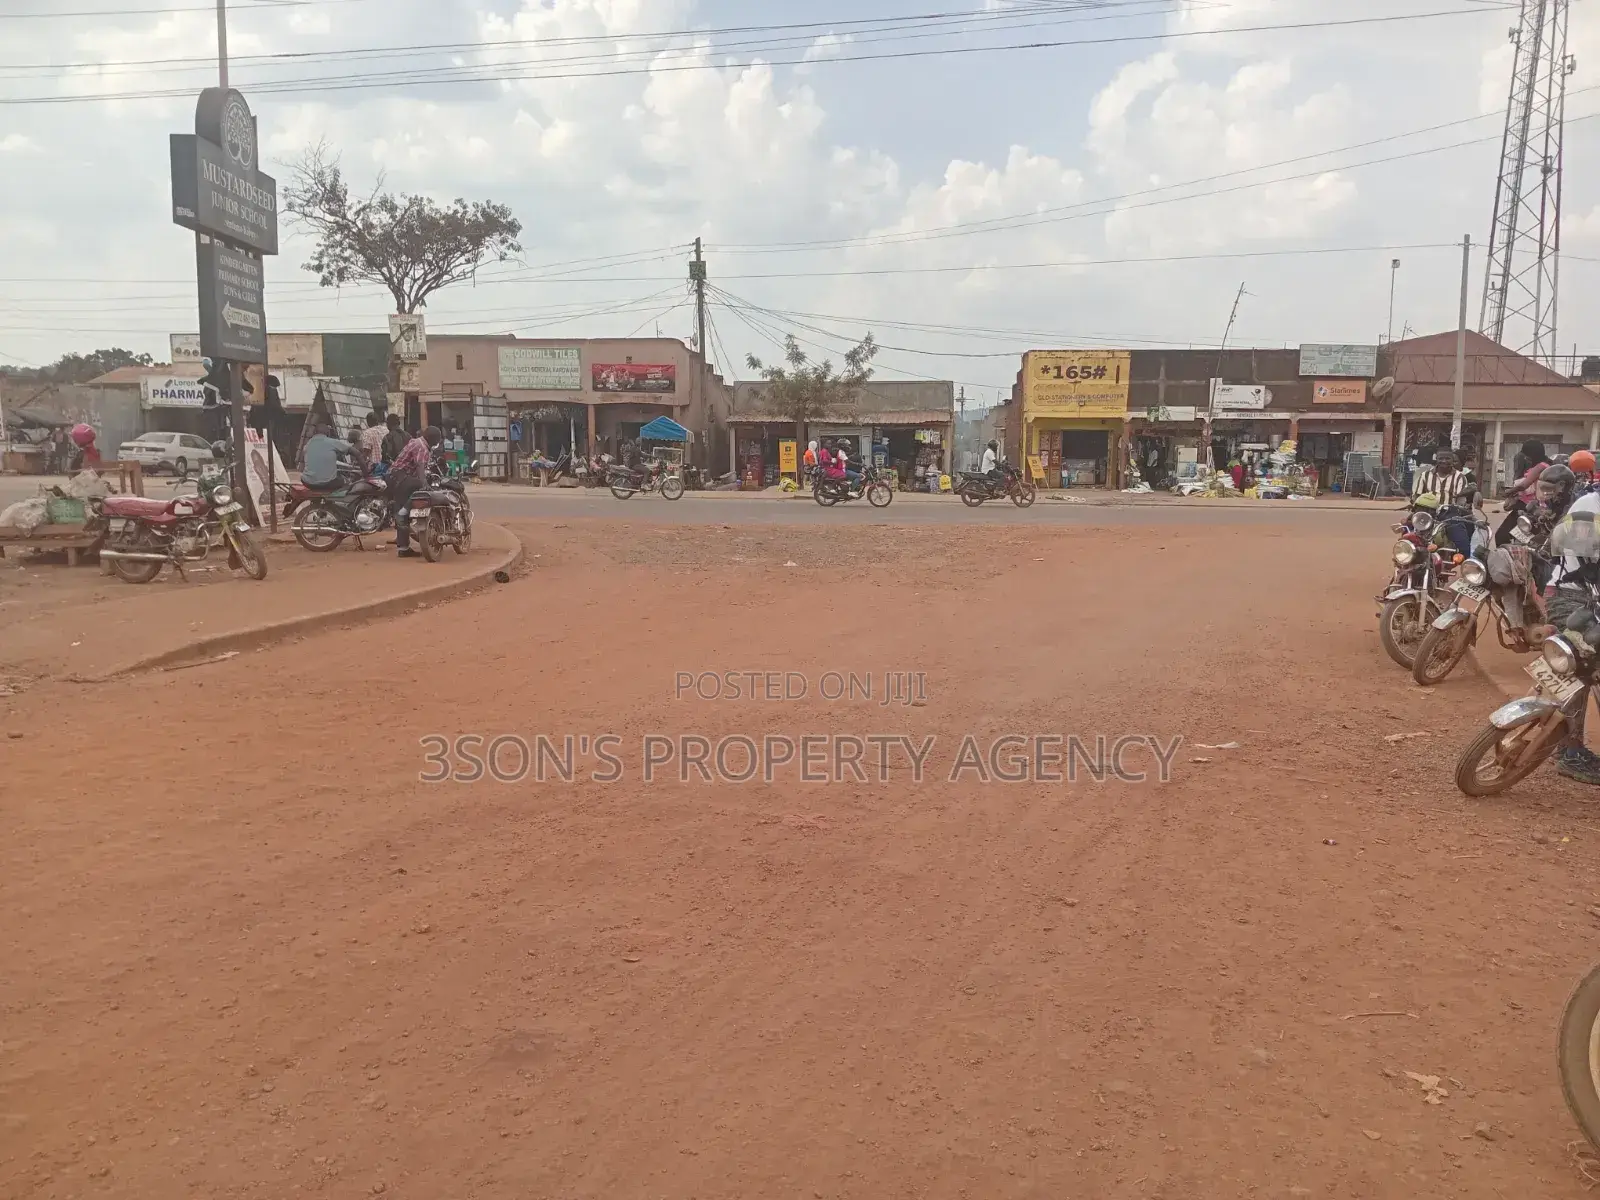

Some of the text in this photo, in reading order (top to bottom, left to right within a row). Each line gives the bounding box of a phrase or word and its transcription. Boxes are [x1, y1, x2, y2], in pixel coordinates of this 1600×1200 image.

[202, 159, 275, 212] MUSTARDSEED
[211, 191, 239, 216] JUNIOR
[240, 205, 268, 230] SCHOOL
[554, 348, 578, 359] TILES
[1536, 671, 1567, 694] 427V
